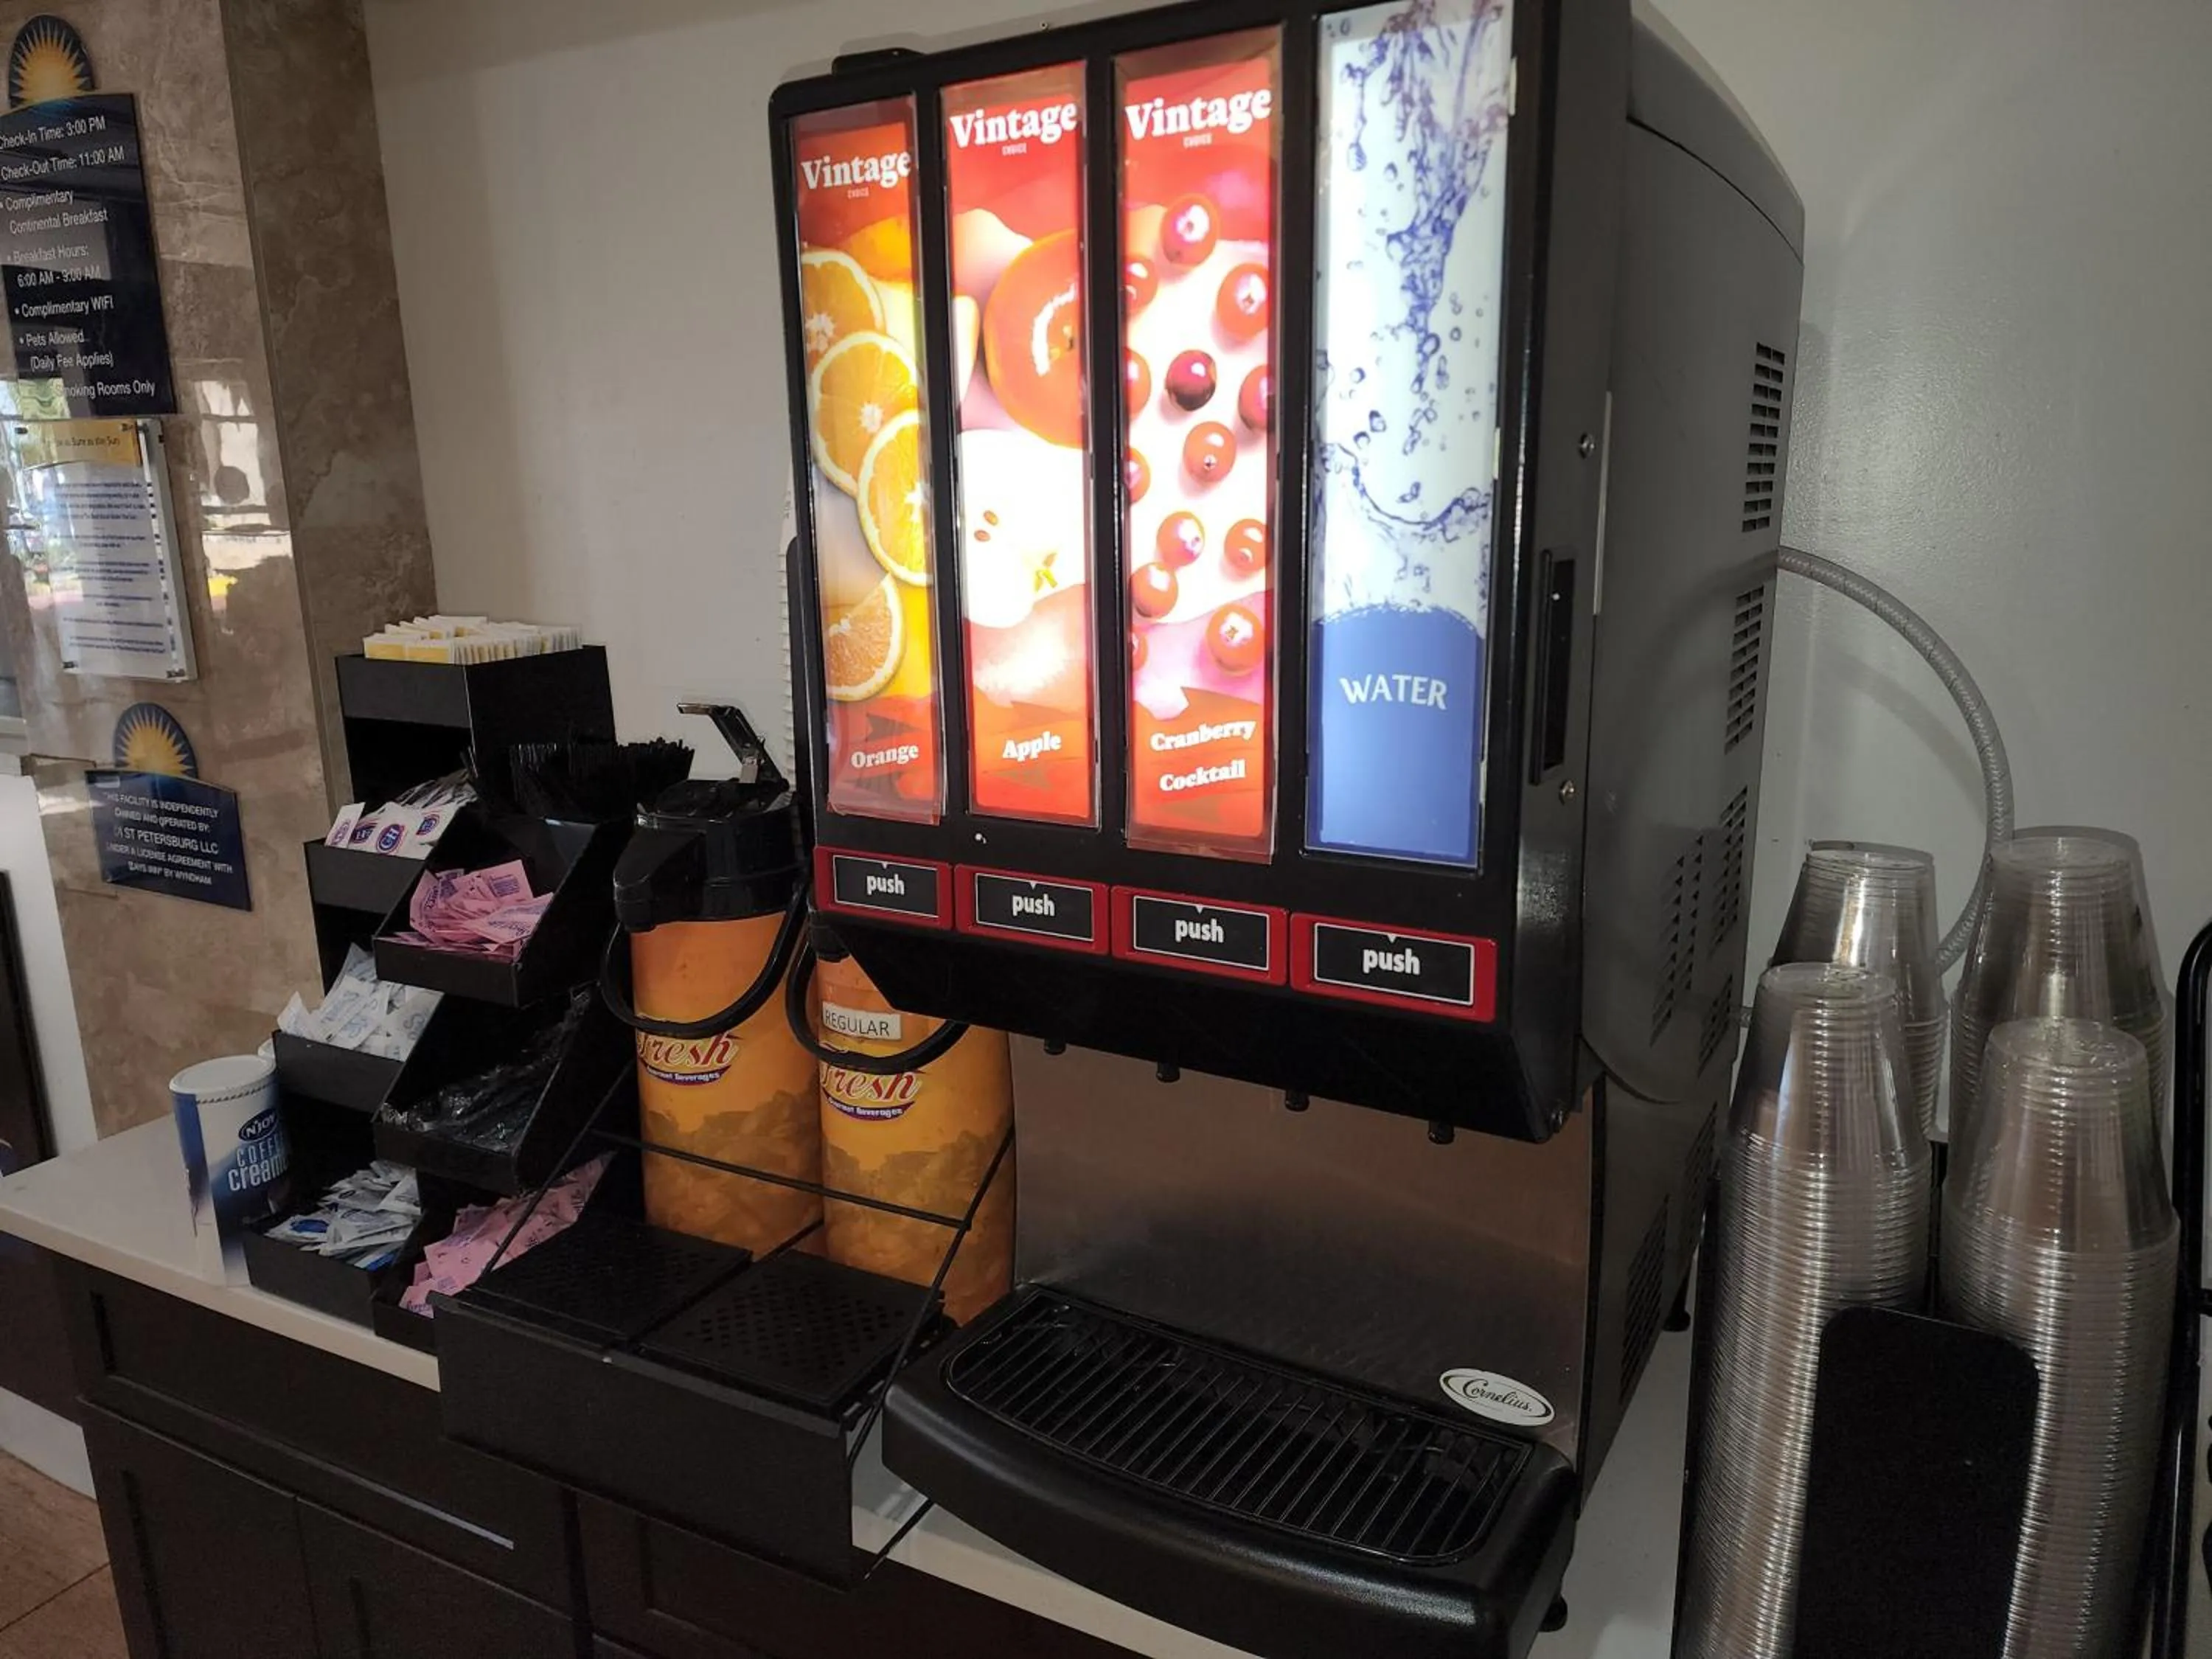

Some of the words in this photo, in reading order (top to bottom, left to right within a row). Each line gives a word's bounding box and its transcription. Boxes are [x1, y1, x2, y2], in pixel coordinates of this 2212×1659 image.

[949, 102, 1077, 148] Vintage
[1124, 88, 1271, 140] Vintage
[38, 126, 64, 142] Time:
[66, 119, 87, 136] 3:00
[88, 115, 106, 133] PM
[1, 158, 49, 181] Check-Out
[49, 157, 77, 172] Time:
[79, 149, 105, 166] 11:00
[108, 145, 125, 163] AM
[800, 151, 911, 189] Vintage
[5, 190, 74, 212] Complimentary
[10, 215, 60, 234] Continental
[63, 207, 108, 226] Breakfast
[13, 248, 56, 263] Breakfast
[18, 273, 36, 288] 6:00
[39, 271, 54, 285] AM
[21, 300, 89, 319] Complimentary
[26, 333, 46, 347] Pets
[49, 330, 85, 344] Allowed
[30, 355, 55, 372] (Daily
[57, 354, 74, 368] Fee
[76, 350, 114, 369] Applies)
[97, 381, 131, 396] Rooms
[133, 379, 156, 397] Only
[1339, 673, 1447, 710] WATER
[1002, 731, 1062, 762] Apple
[1150, 720, 1256, 752] Cranberry
[851, 744, 919, 768] Orange
[1159, 759, 1245, 792] Cocktail
[124, 827, 135, 840] ST
[137, 830, 199, 852] PETERSBURG
[200, 839, 220, 855] LLC
[866, 874, 905, 895] push
[1012, 893, 1055, 917] push
[1175, 918, 1225, 943] push
[1362, 947, 1421, 975] push
[824, 1010, 890, 1037] REGULAR
[1462, 1378, 1530, 1411] Cornelius
